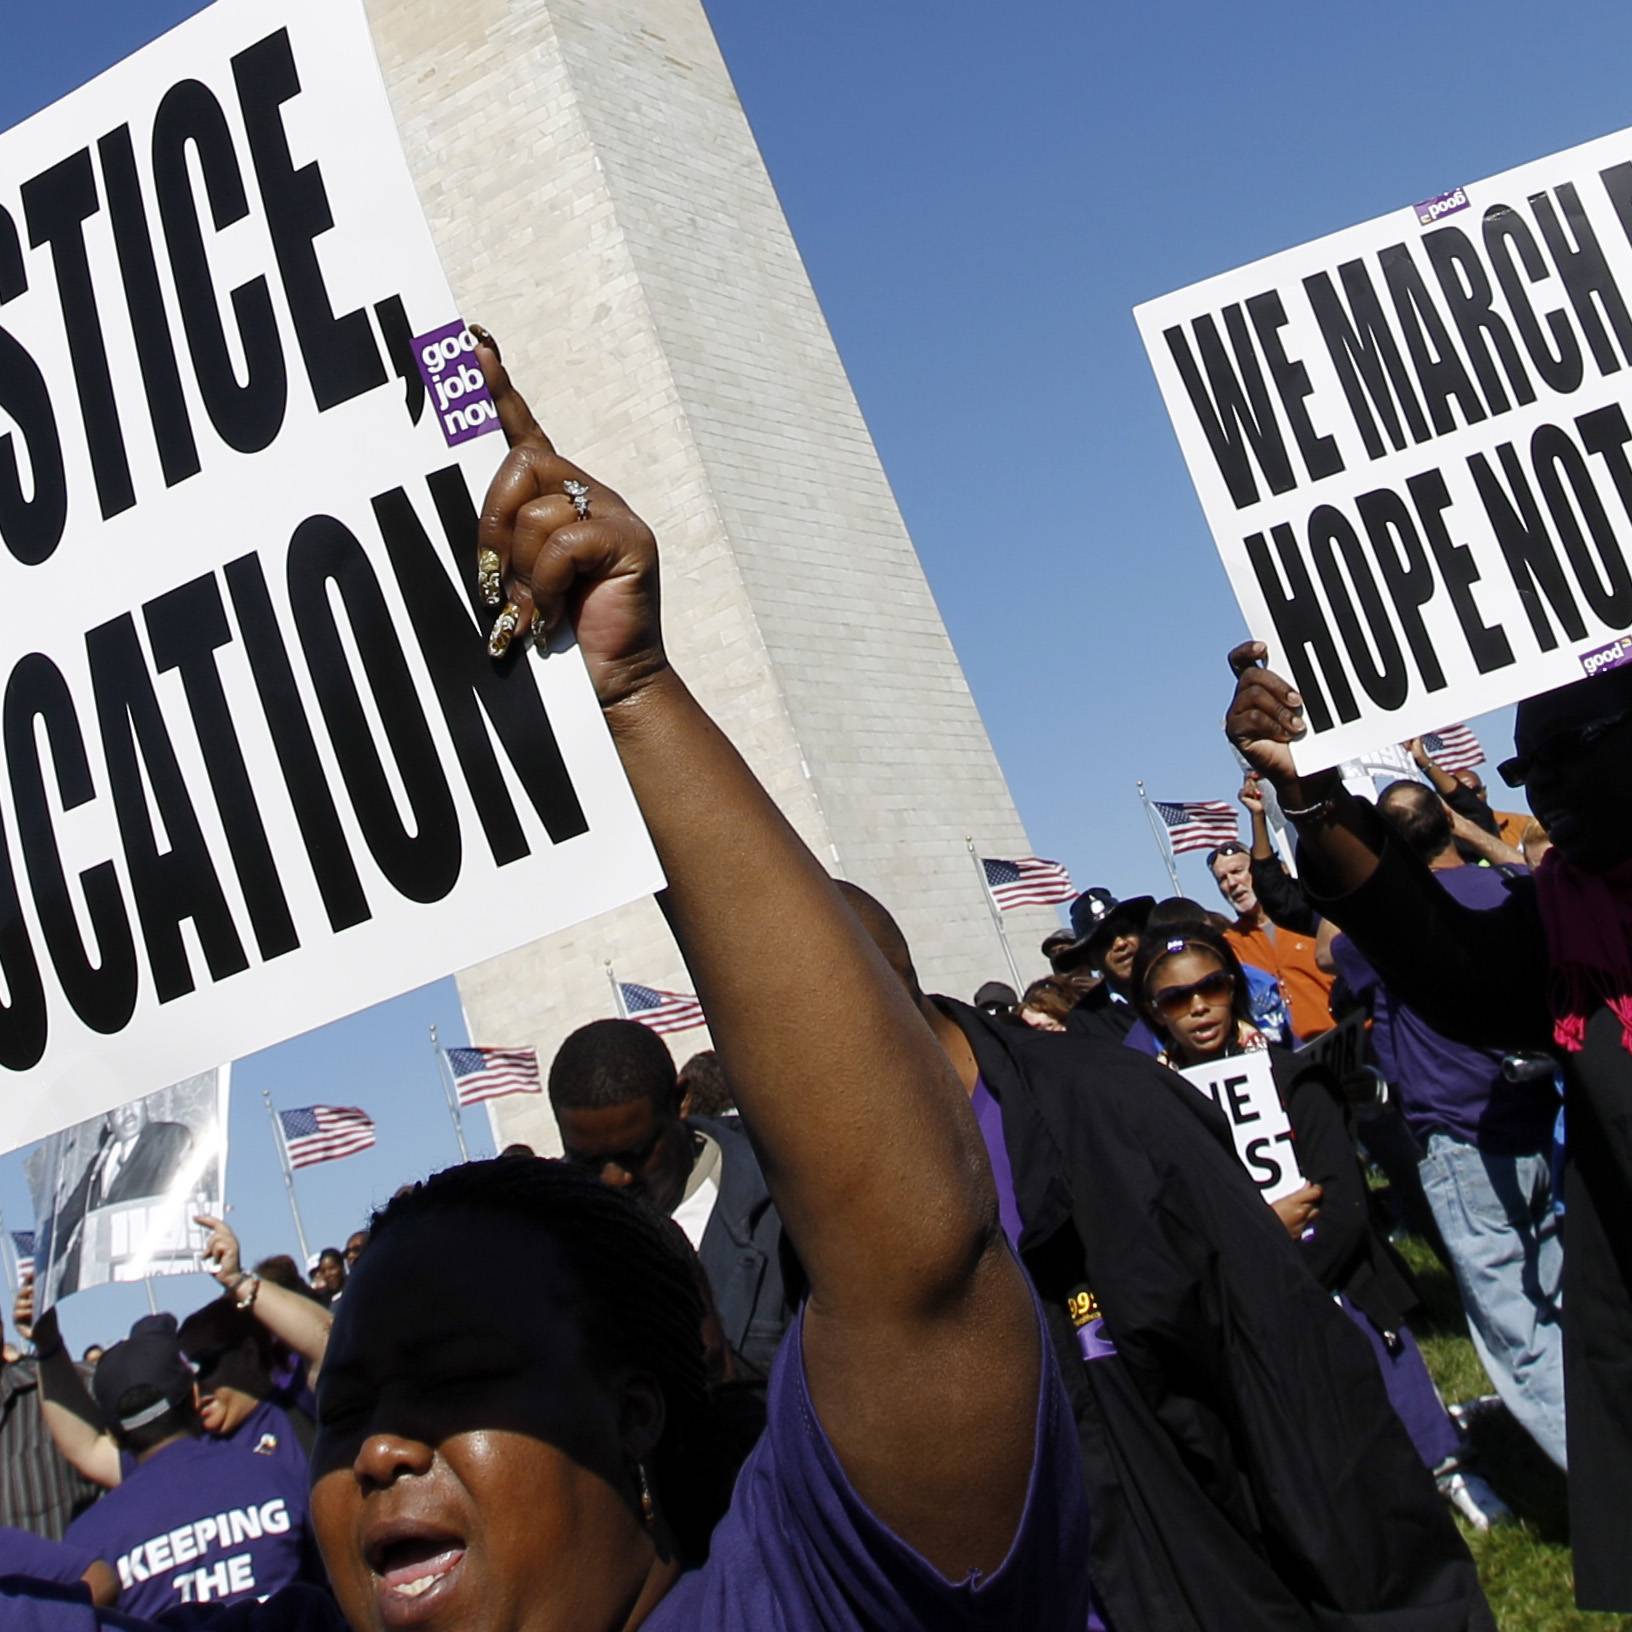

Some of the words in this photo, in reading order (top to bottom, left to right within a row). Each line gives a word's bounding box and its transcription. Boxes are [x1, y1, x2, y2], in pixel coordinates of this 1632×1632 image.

[1428, 191, 1465, 219] good
[432, 364, 484, 411] job
[1163, 290, 1345, 509] WE
[1244, 468, 1516, 734] HOPE
[1584, 642, 1624, 673] good
[117, 1498, 291, 1590] KEEPING
[173, 1553, 256, 1603] THE
